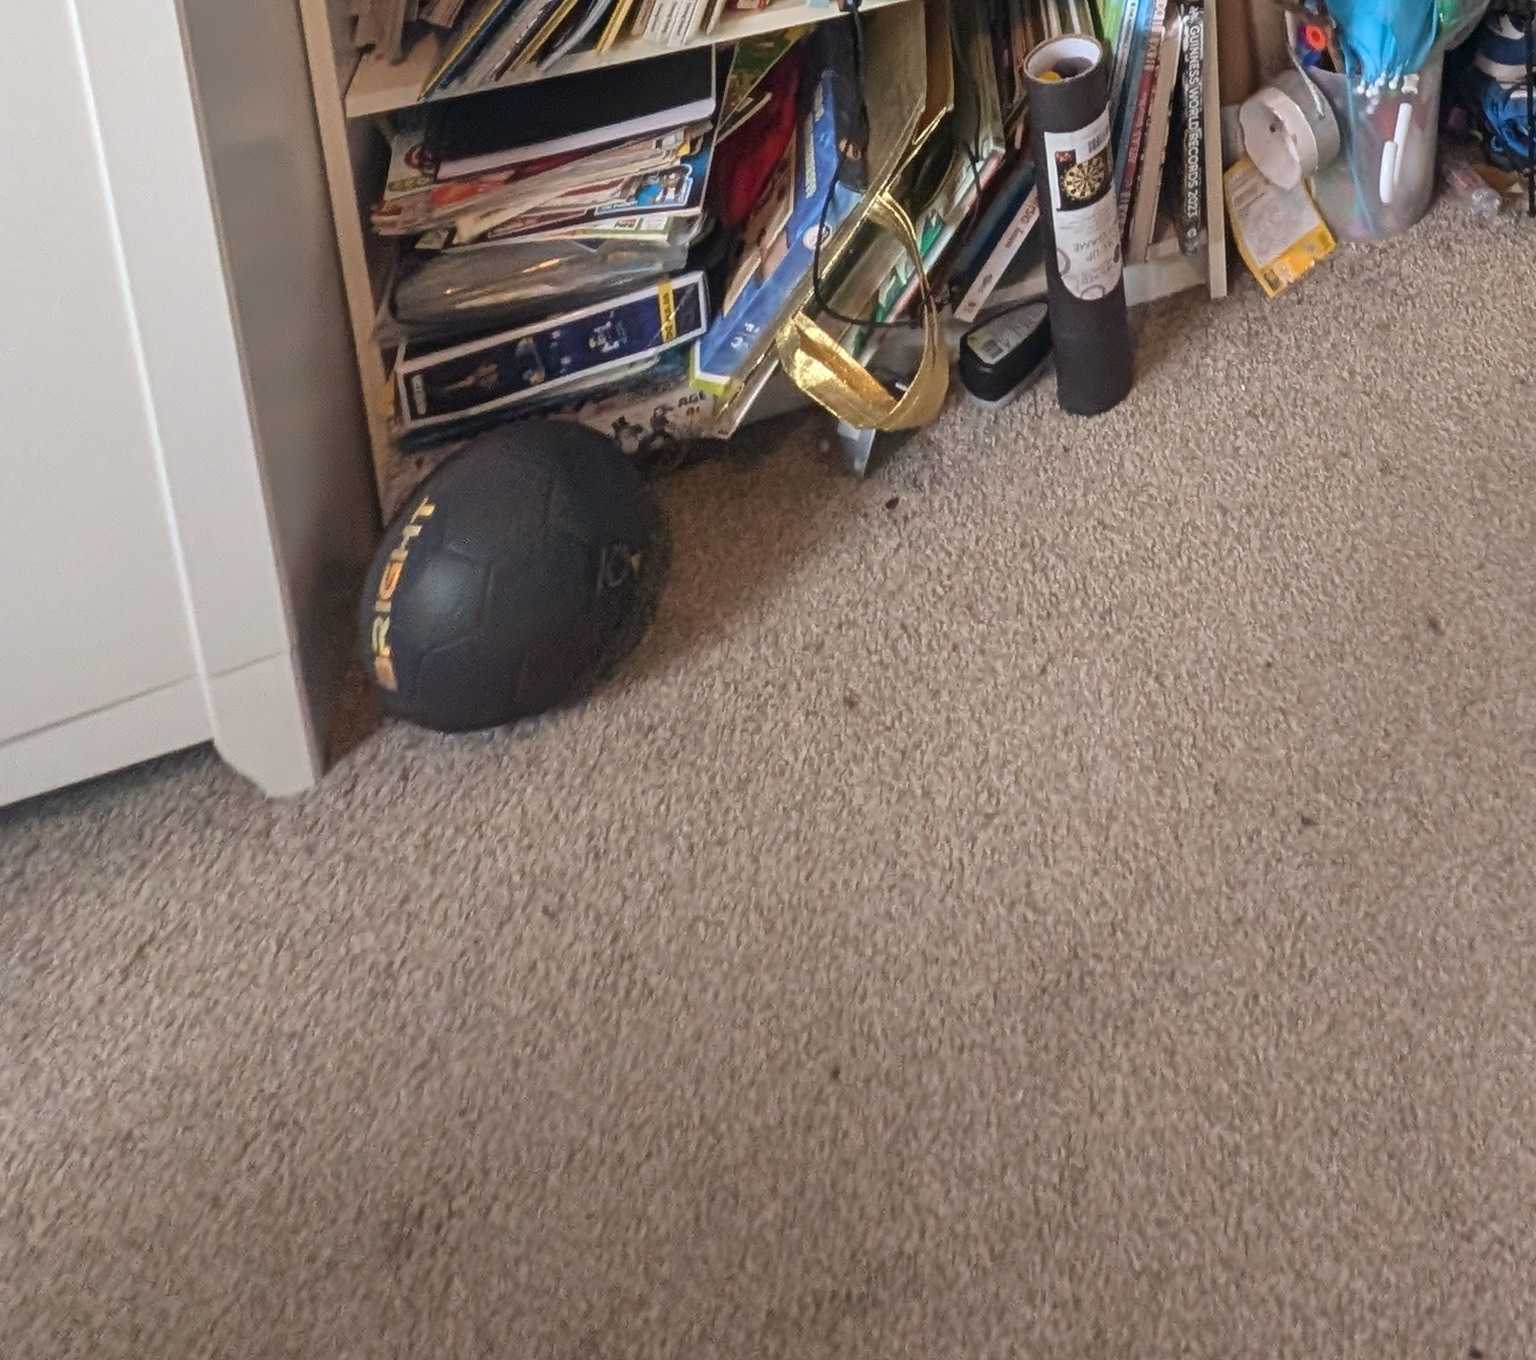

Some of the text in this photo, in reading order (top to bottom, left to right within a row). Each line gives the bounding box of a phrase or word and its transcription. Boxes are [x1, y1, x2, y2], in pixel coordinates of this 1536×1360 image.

[1187, 21, 1204, 219] GUINNESS WORLD RECORDS 2023
